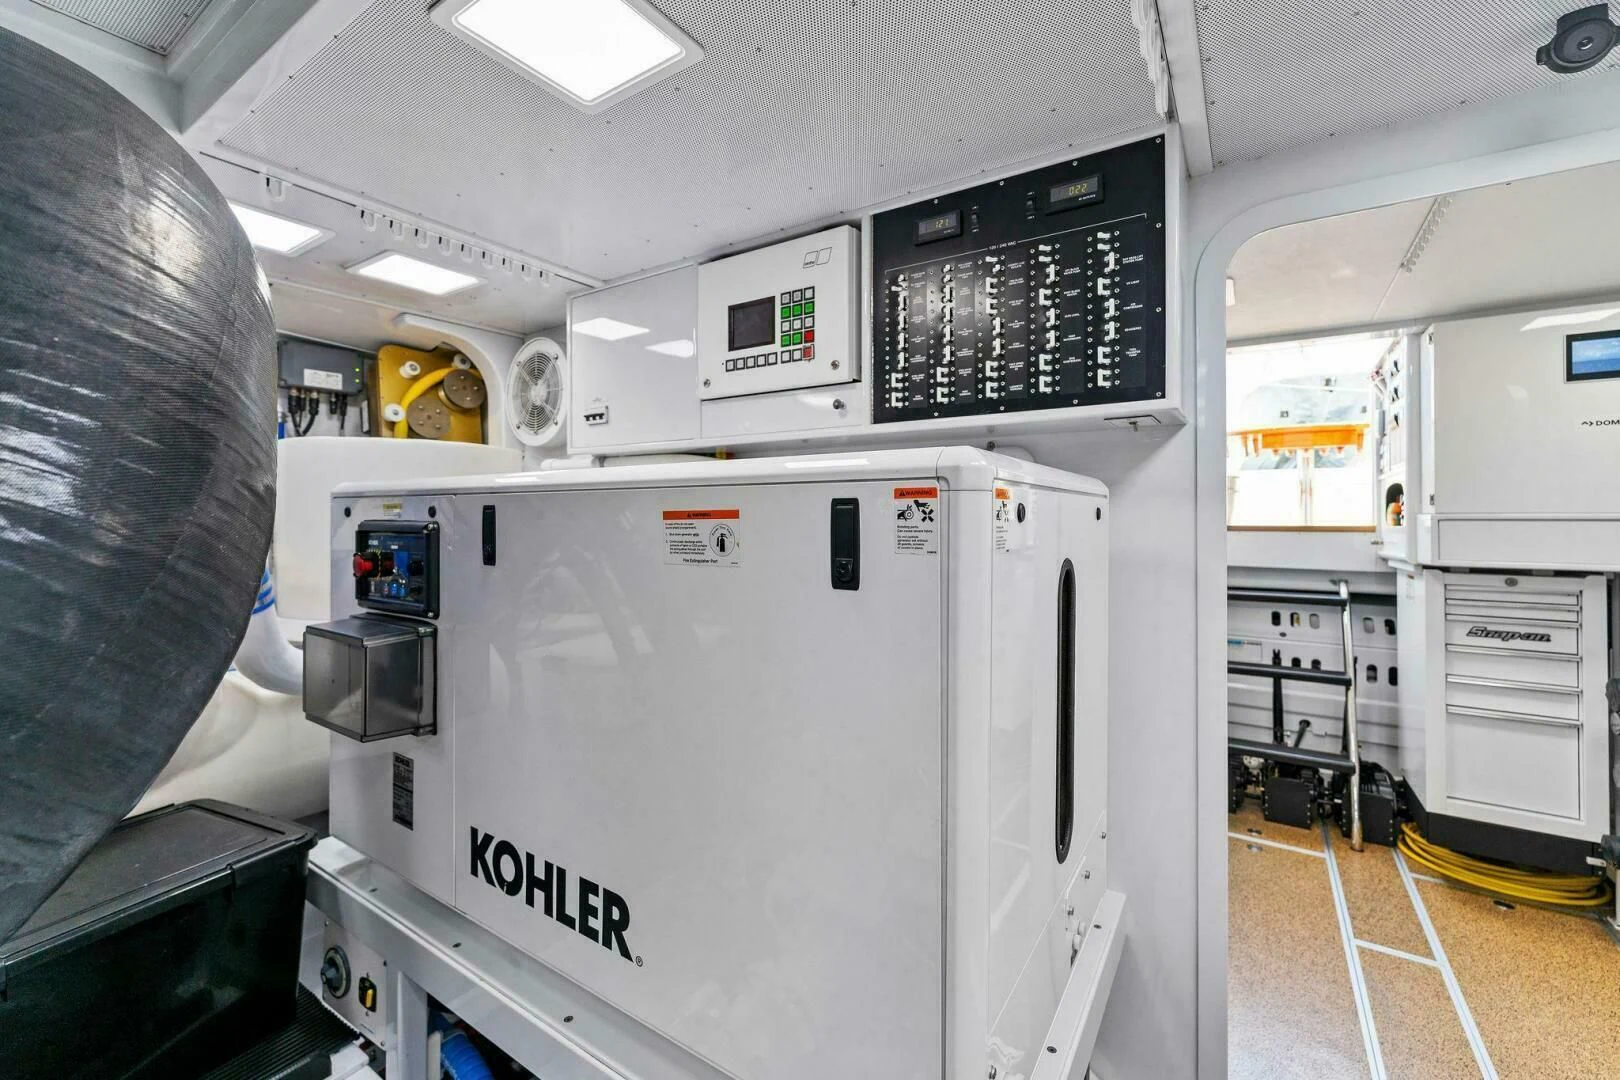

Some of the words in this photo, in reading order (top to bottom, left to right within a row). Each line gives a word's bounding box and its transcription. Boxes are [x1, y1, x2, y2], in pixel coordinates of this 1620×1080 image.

[1069, 183, 1087, 196] 022
[1466, 626, 1552, 642] Snap-on
[470, 825, 634, 963] KOHLER
